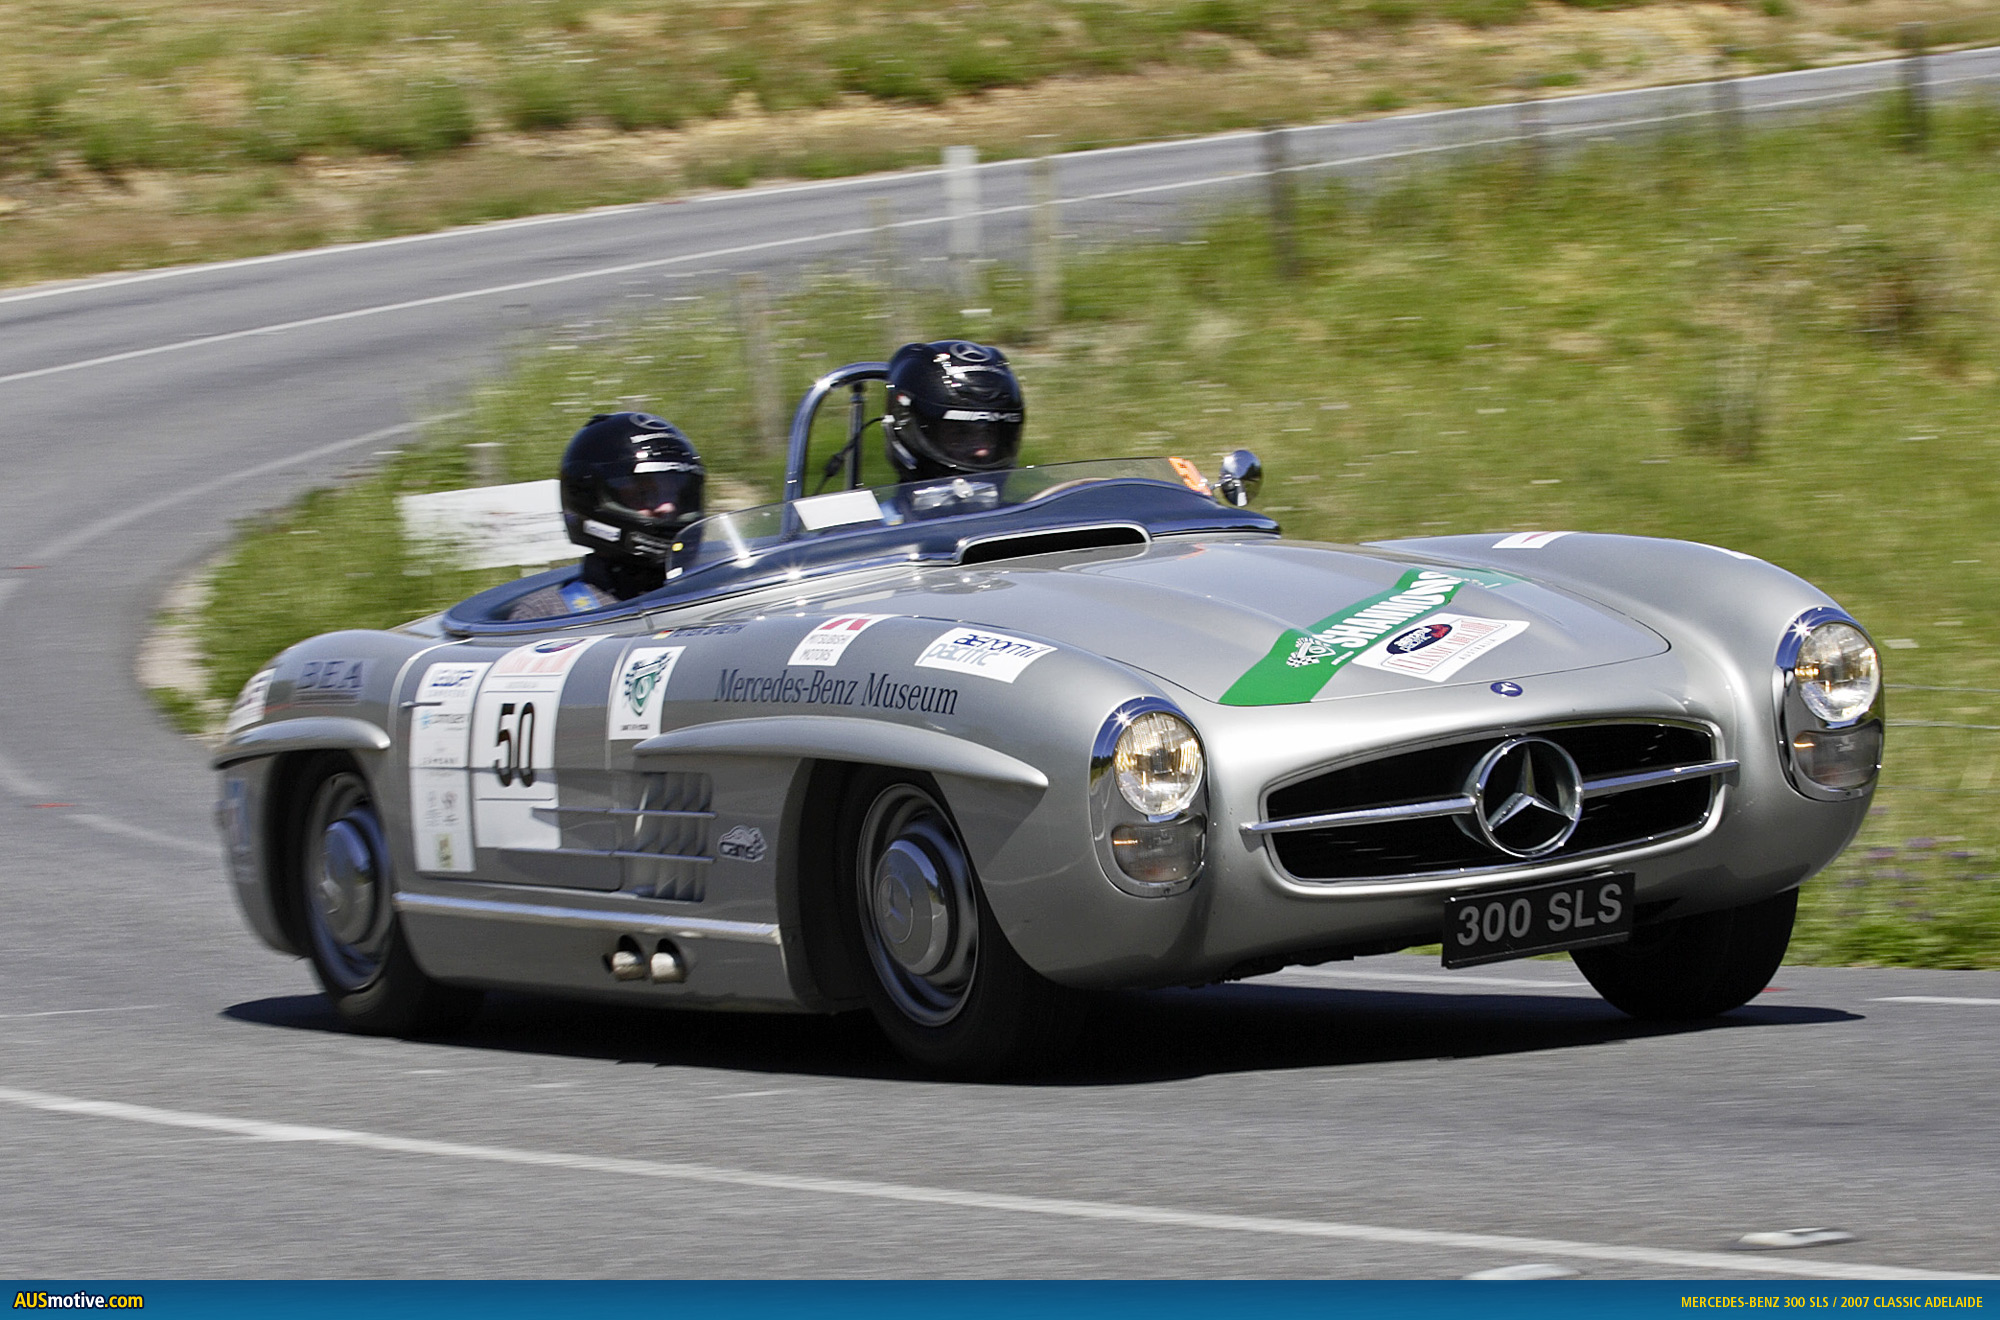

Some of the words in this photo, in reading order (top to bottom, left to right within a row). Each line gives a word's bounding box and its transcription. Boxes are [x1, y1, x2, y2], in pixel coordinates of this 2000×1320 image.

[1315, 571, 1462, 648] SHANNONS
[917, 643, 1002, 666] pacific
[713, 668, 859, 706] Mercedes-Benz
[860, 672, 959, 716] Museum
[493, 702, 535, 788] 50
[1457, 898, 1532, 947] 300
[1547, 883, 1623, 932] SLS
